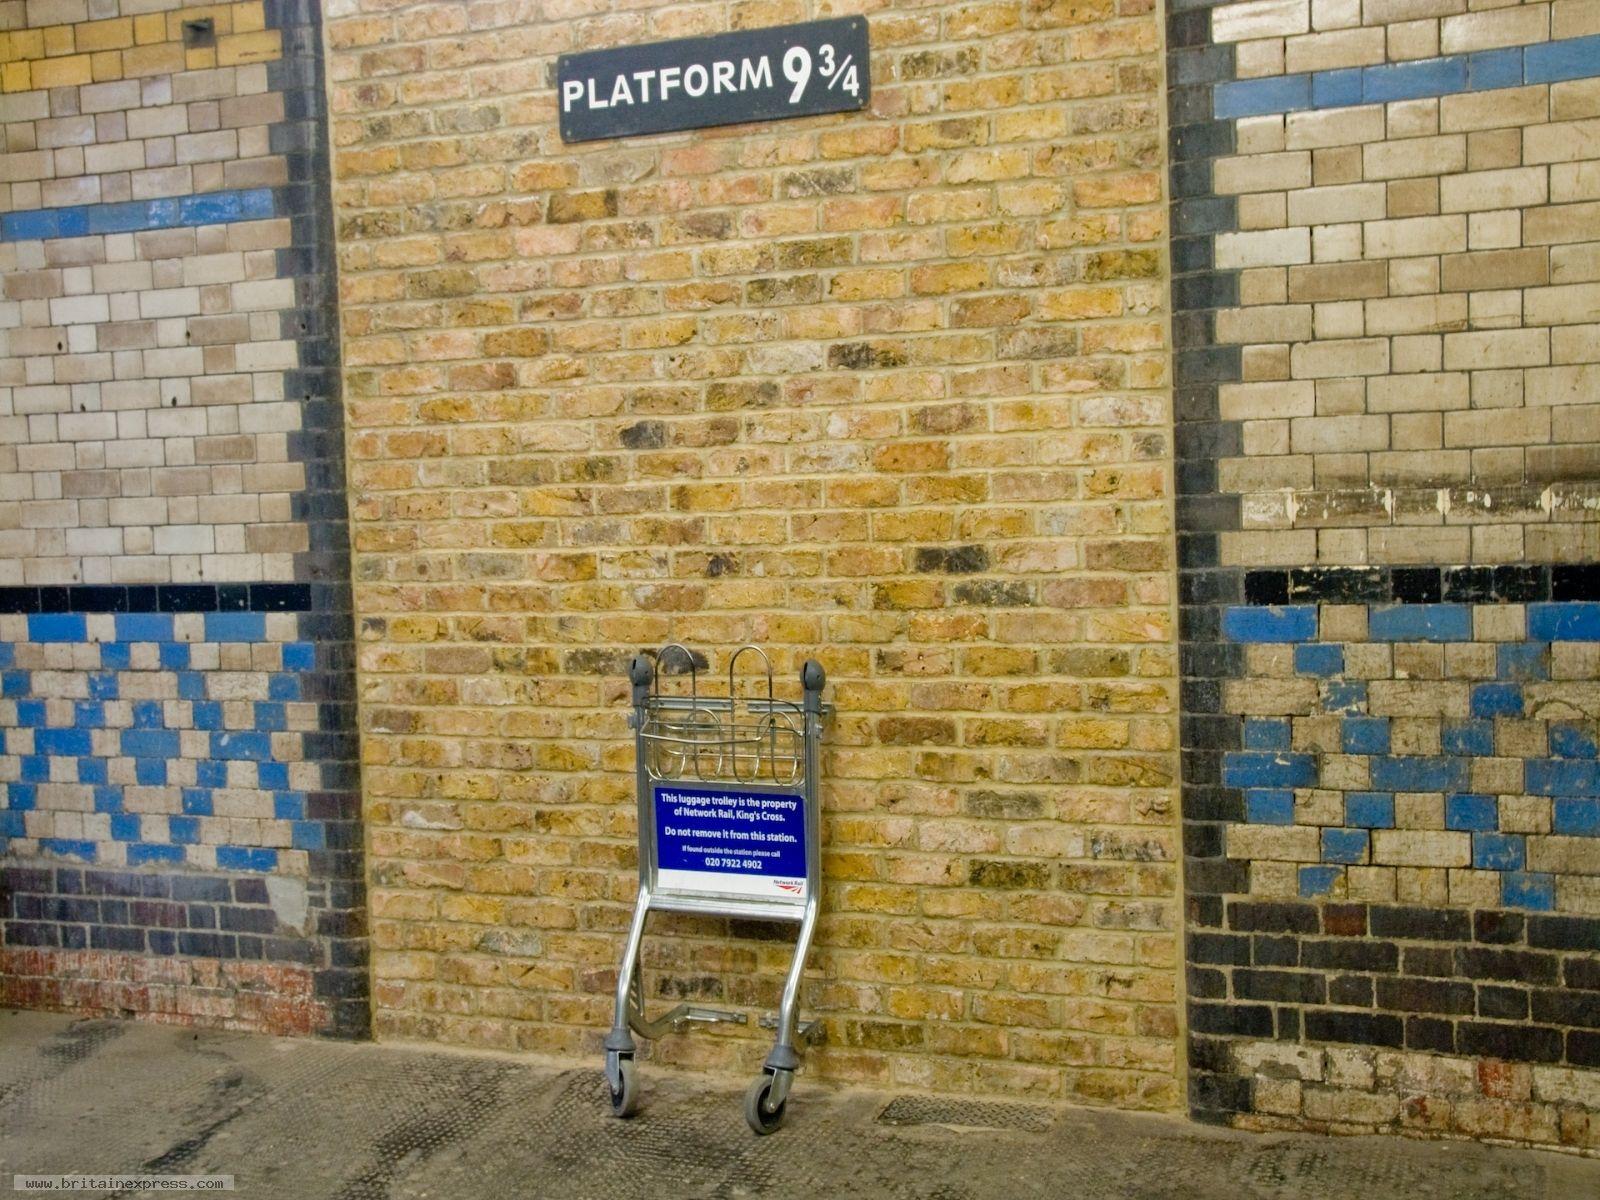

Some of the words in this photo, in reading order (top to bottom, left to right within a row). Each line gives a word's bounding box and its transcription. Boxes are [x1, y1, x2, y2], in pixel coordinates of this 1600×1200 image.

[563, 55, 773, 112] PLATFORM
[782, 46, 812, 104] 9
[661, 793, 677, 802] This
[679, 795, 710, 806] luggage
[712, 796, 737, 807] trolley
[739, 797, 745, 806] is
[747, 798, 760, 807] the
[762, 800, 797, 811] property
[674, 808, 683, 816] of
[684, 808, 717, 818] Network
[718, 810, 735, 819] Rail,
[736, 811, 760, 822] King's
[761, 812, 785, 821] Cross.
[665, 827, 676, 835] Do
[692, 830, 721, 838] remove
[723, 829, 729, 838] it
[730, 830, 749, 840] from
[750, 831, 766, 840] this
[767, 832, 797, 842] station.
[687, 845, 702, 853] found
[703, 846, 723, 854] outside
[753, 849, 770, 857] please
[705, 858, 720, 866] 020
[721, 858, 740, 868] 7922
[743, 860, 762, 869] 4902
